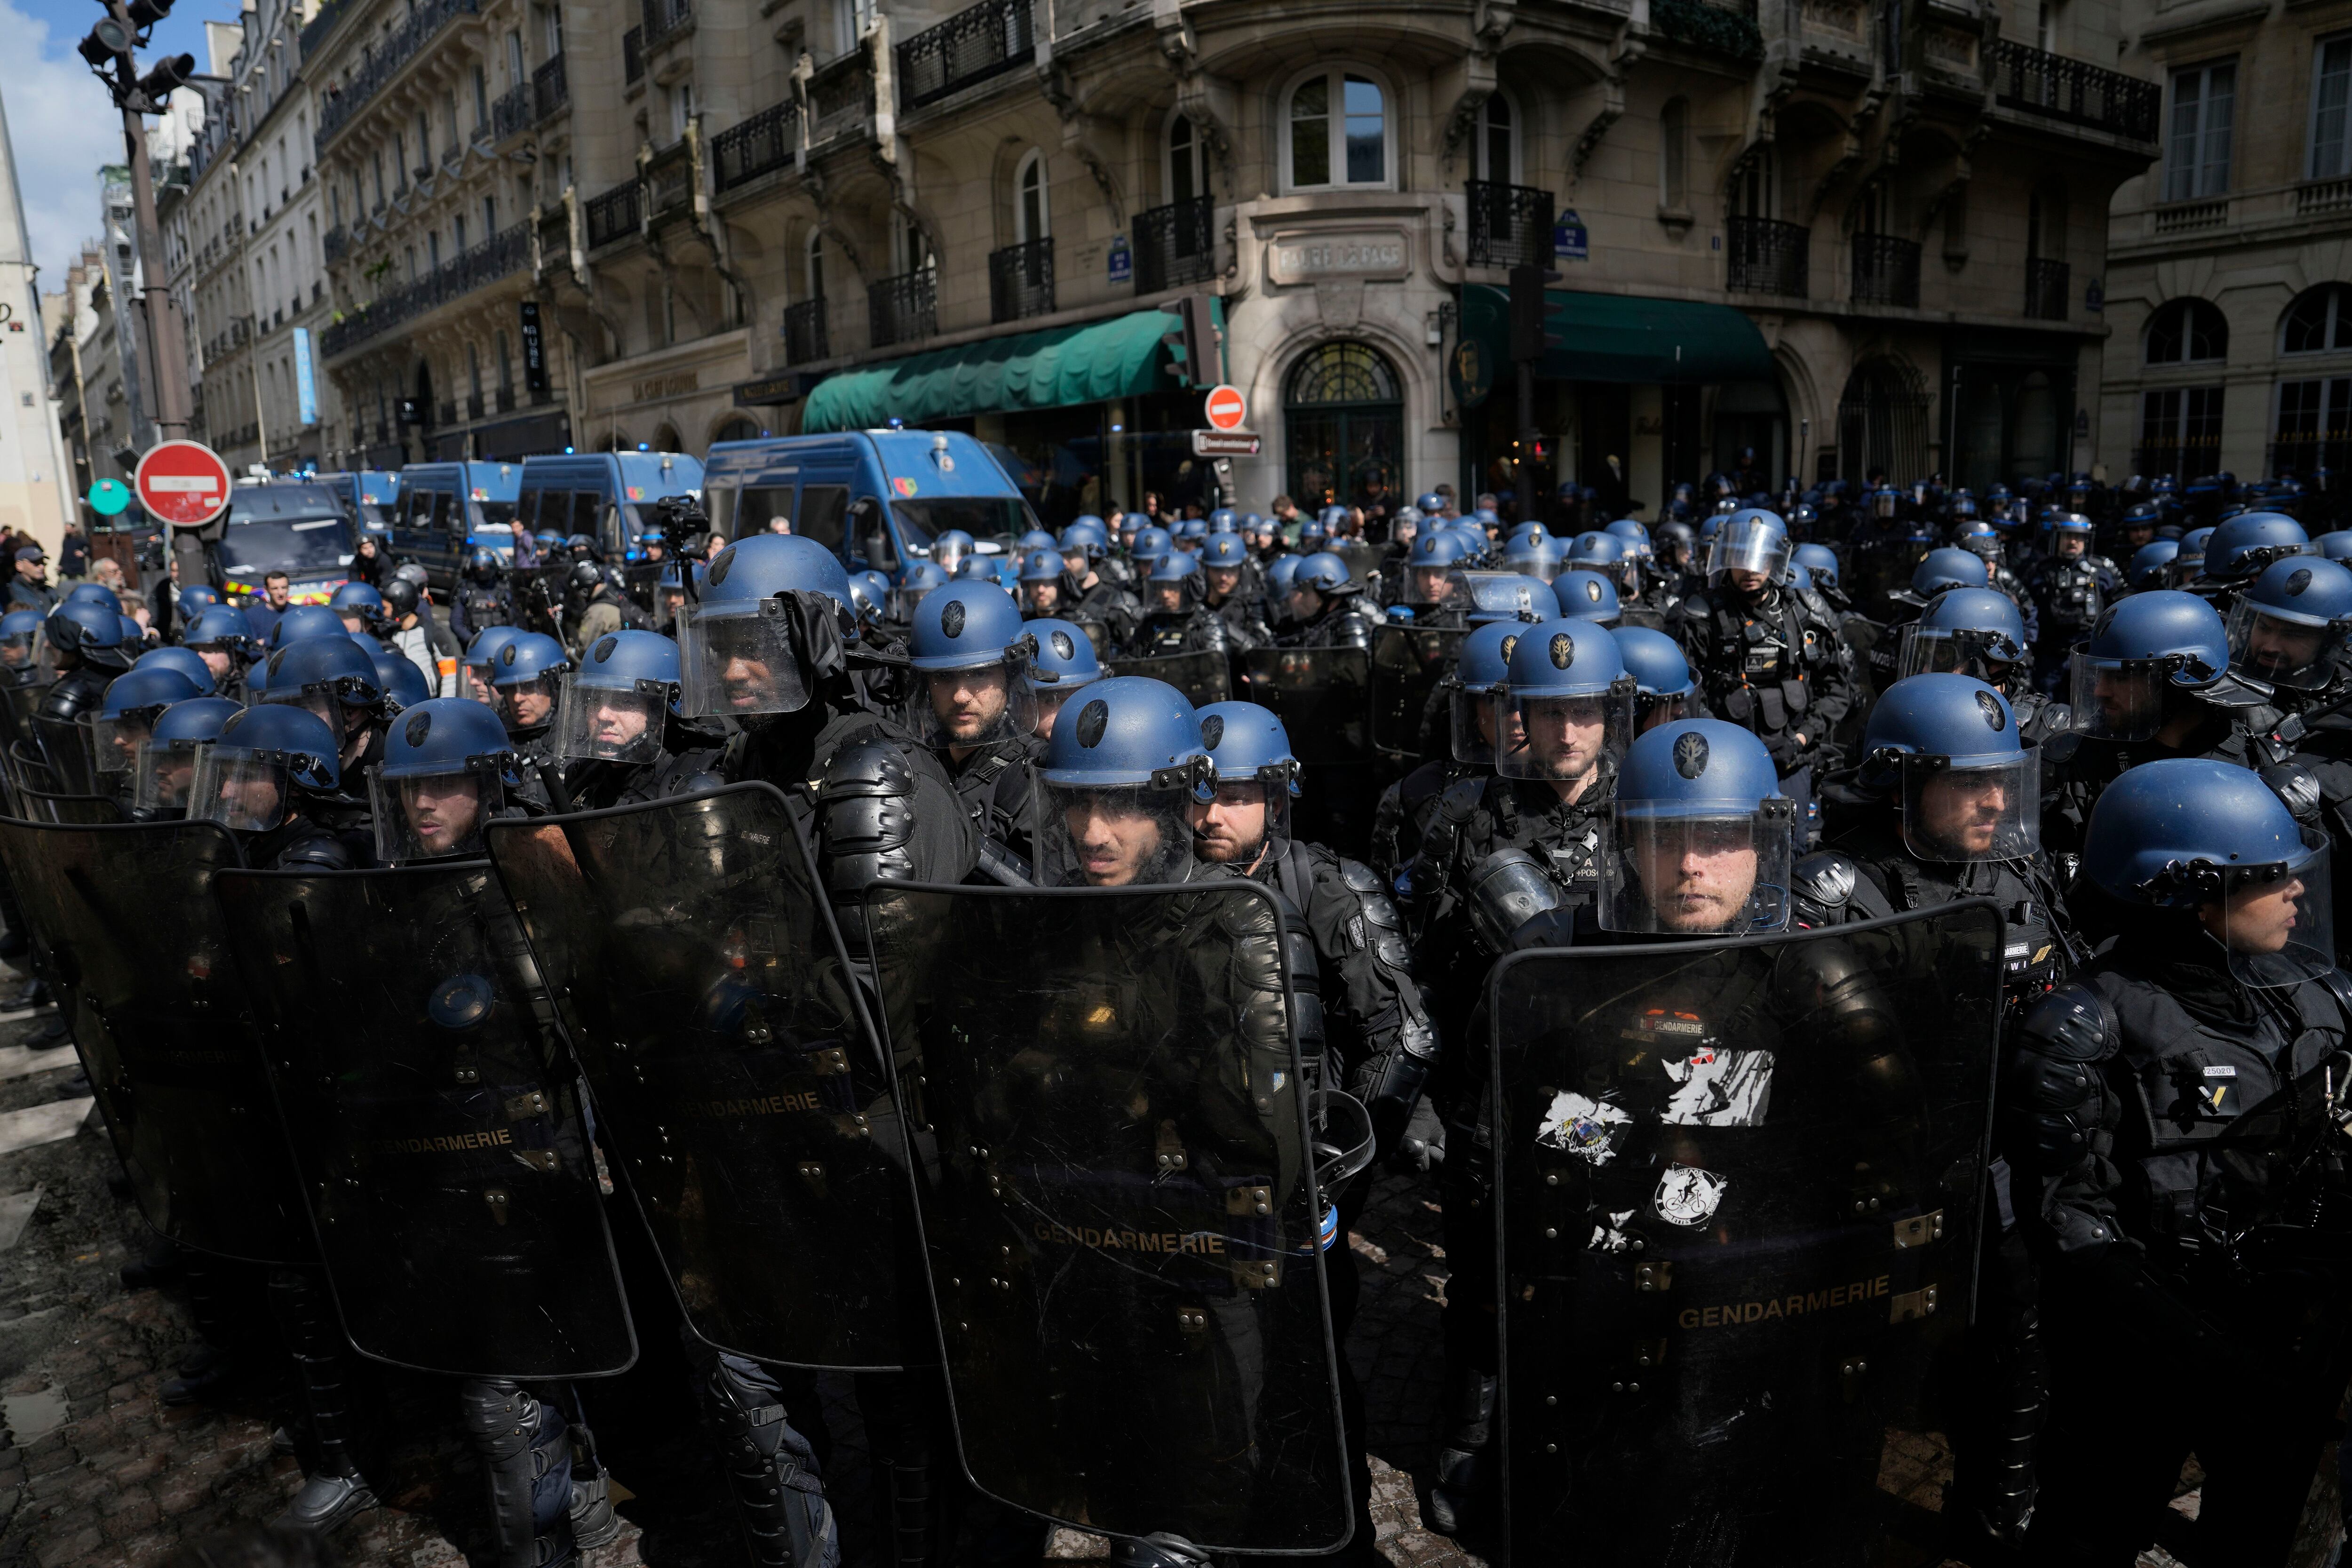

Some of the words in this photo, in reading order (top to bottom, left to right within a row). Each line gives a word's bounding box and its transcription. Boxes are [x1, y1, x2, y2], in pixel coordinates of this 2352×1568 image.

[1584, 858, 1593, 867] A
[1654, 1019, 1704, 1035] GENDARMERIE
[676, 1091, 822, 1118] GENDARMERIE
[372, 1129, 513, 1154] GENDARMERIE
[1660, 1208, 1692, 1225] ROULETTES
[1034, 1221, 1225, 1254] GENDARMERIE
[1678, 1274, 1890, 1330] GENDARMERIE
